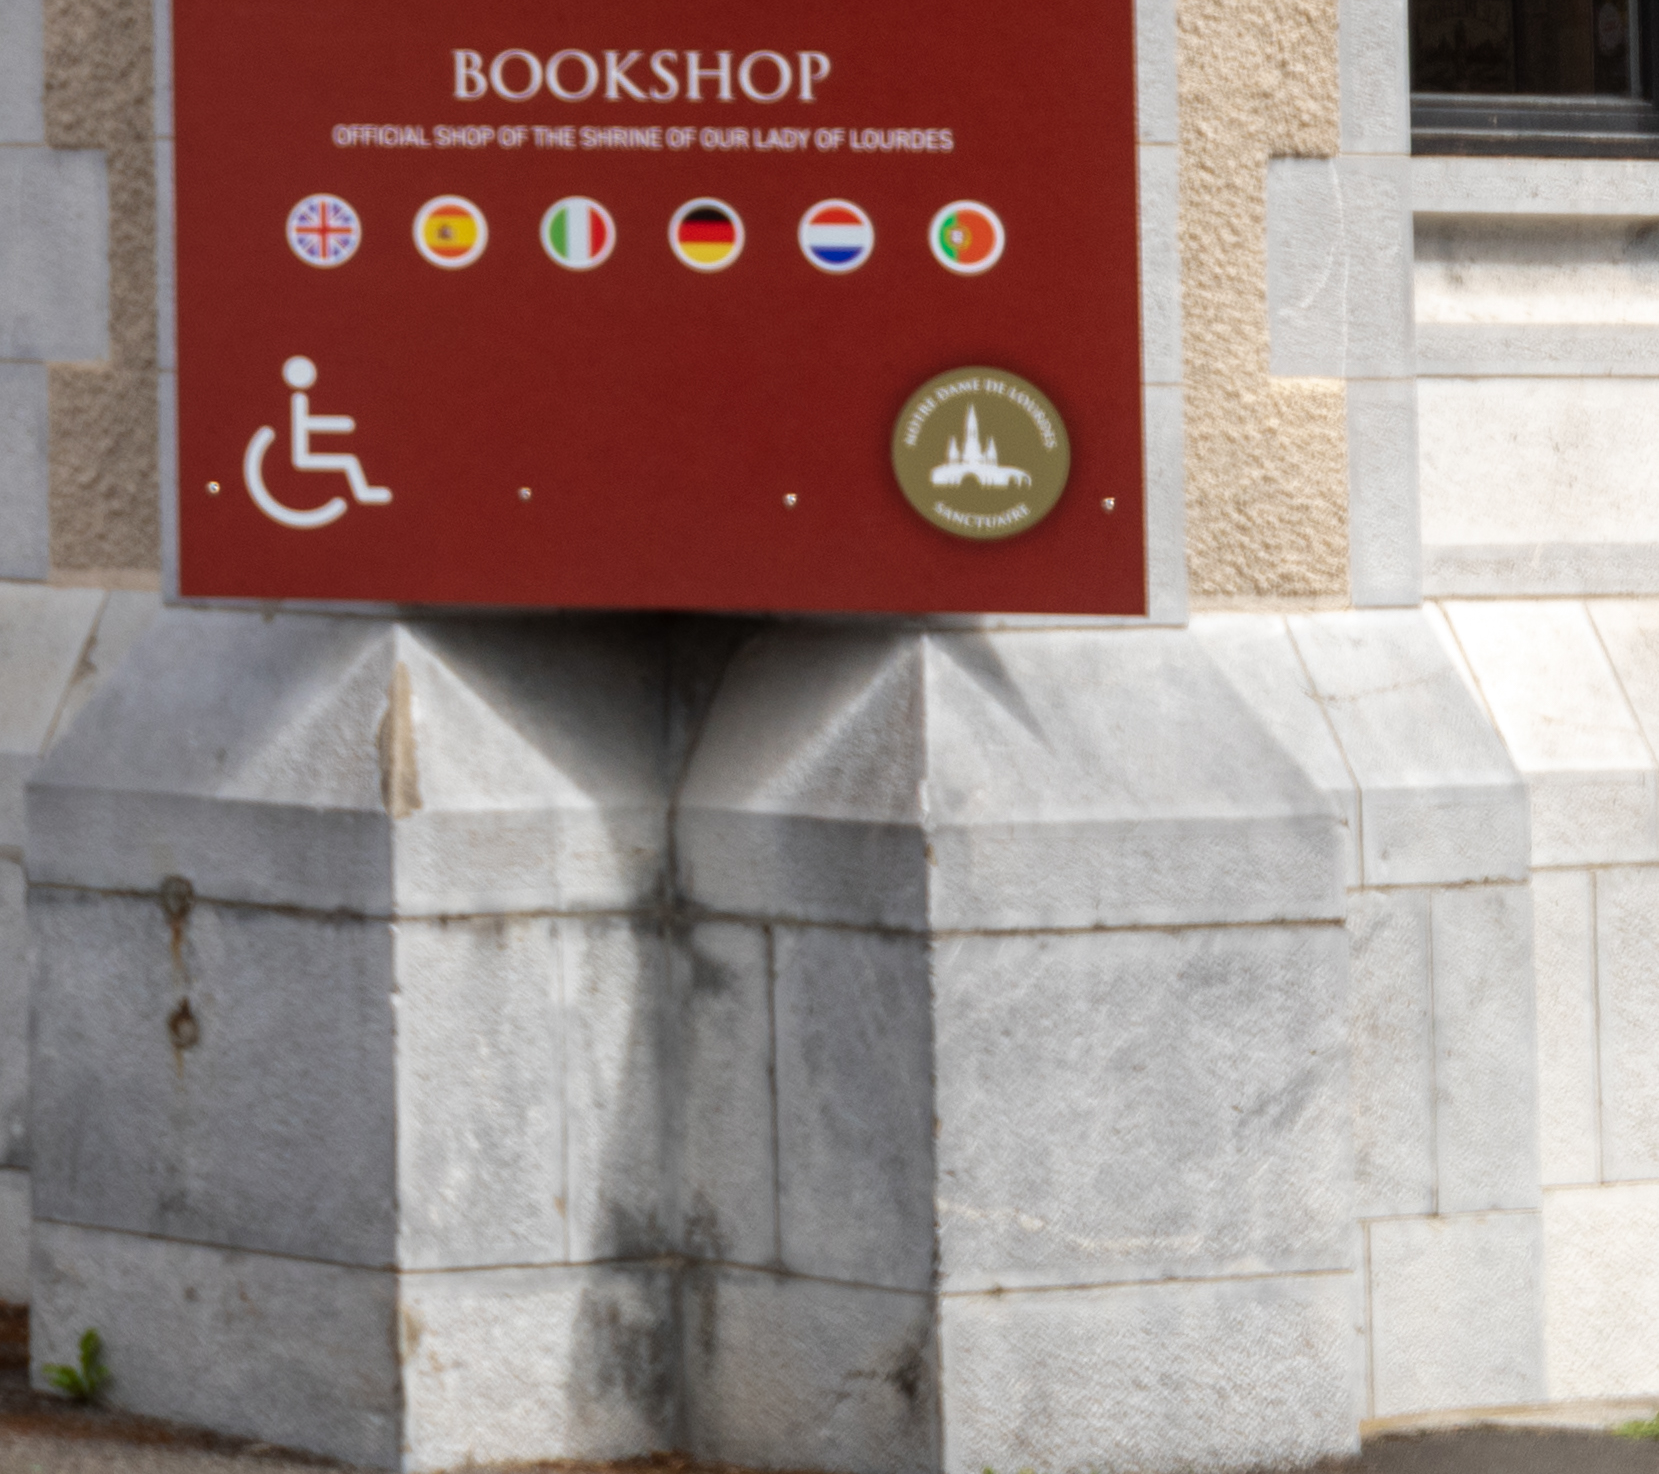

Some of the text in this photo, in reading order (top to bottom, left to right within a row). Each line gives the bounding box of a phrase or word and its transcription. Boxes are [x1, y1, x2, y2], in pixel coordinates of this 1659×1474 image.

[451, 48, 831, 103] BOOKSHOP
[332, 124, 954, 151] OFFICIAL SHOP OF THE SHRINE OF OUR LADY OF LOURDES
[904, 377, 1058, 450] NOTRE DAME DE LOURDES
[934, 501, 1031, 528] SANCTUAIRE
